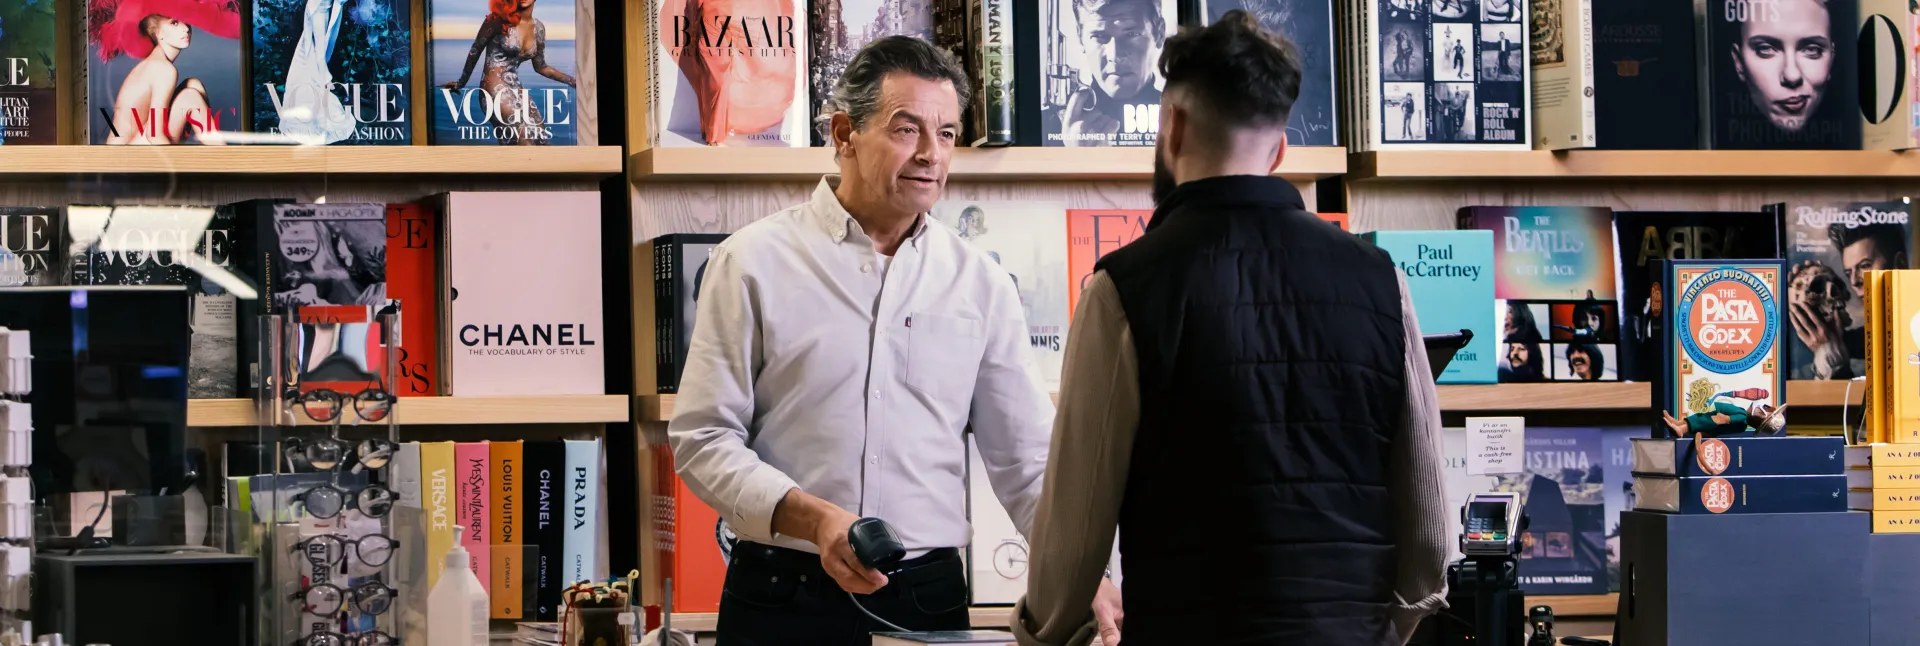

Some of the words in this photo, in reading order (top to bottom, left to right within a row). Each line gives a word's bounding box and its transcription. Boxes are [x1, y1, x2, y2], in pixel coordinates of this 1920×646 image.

[1724, 0, 1780, 22] GOTTS
[673, 15, 795, 48] BAZAAR
[671, 48, 754, 57] GREATEST
[761, 48, 796, 57] HITS
[990, 59, 1005, 100] 1900
[4, 106, 29, 118] ART
[263, 82, 404, 123] VOGUE
[440, 87, 571, 125] VOGUE
[1483, 107, 1509, 118] ROCK
[131, 107, 236, 138] MUSIC
[1123, 104, 1160, 133] BON
[1483, 118, 1505, 129] ROLL
[4, 130, 29, 138] PEOPLE
[457, 126, 490, 140] THE
[494, 126, 553, 140] COVERS
[1483, 129, 1515, 140] ALBUM
[1728, 119, 1843, 143] PHOTOGRAPH
[283, 208, 315, 217] MOOMIN
[1534, 216, 1551, 225] THE
[100, 228, 230, 268] VOGUE
[1073, 236, 1092, 245] THE
[1504, 216, 1583, 259] BEATLES
[1417, 244, 1453, 260] Paul
[1516, 265, 1538, 276] GET
[1543, 265, 1575, 276] BACK
[1685, 271, 1720, 302] VINCENZO
[1723, 270, 1770, 302] BUONASSISI
[1718, 289, 1736, 298] THE
[1701, 293, 1759, 324] PASTA
[459, 324, 595, 346] CHANEL
[1052, 326, 1060, 334] OF
[1698, 324, 1753, 348] CODEX
[1030, 336, 1060, 351] NNIS
[1455, 351, 1478, 361] trätt
[502, 459, 512, 492] LOUIS
[432, 468, 447, 531] VERSACE
[539, 469, 550, 529] CHANEL
[574, 466, 586, 530] PRADA
[1707, 481, 1719, 507] PASTA
[1720, 484, 1729, 508] CODEX
[502, 496, 512, 543] VUITTON
